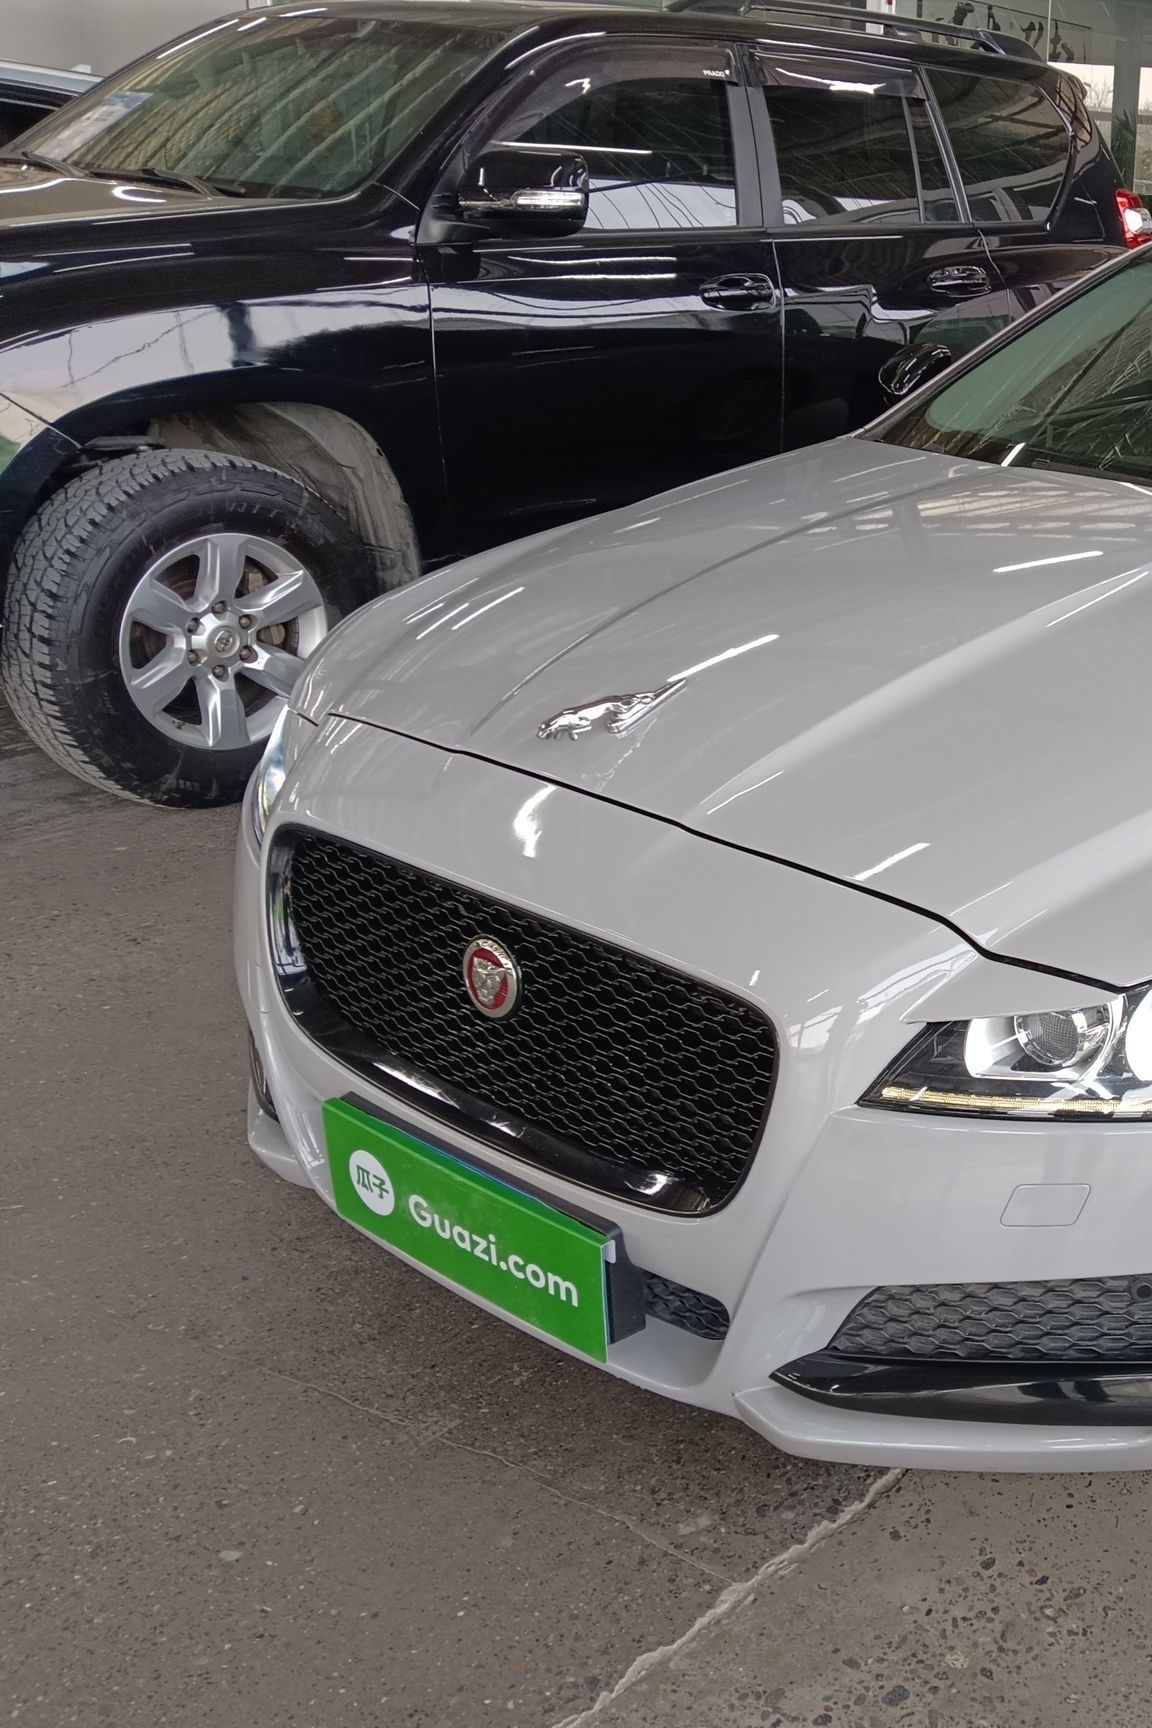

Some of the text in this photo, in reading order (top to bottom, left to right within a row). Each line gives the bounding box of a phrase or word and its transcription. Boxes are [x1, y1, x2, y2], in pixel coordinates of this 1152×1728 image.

[702, 69, 725, 77] PRADO
[356, 1165, 389, 1199] 瓜子
[408, 1194, 579, 1308] Guazi.com
